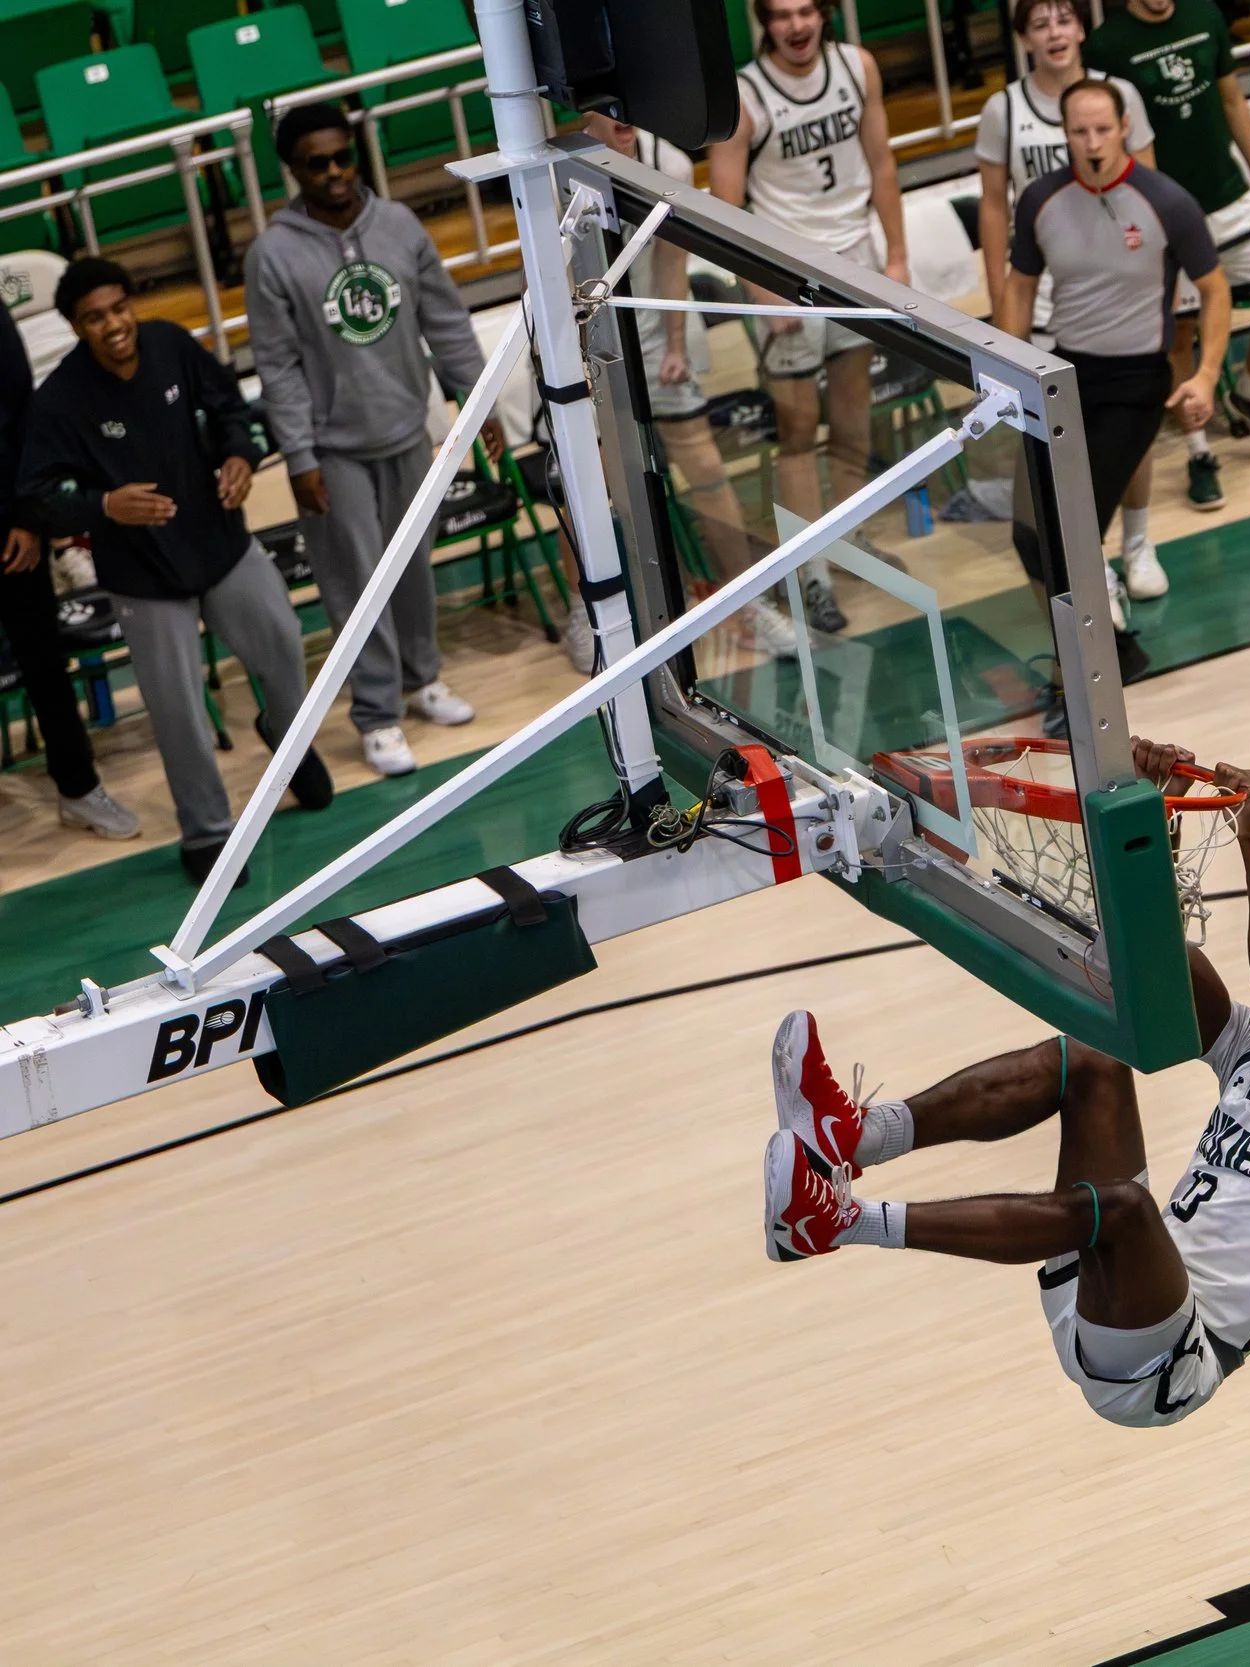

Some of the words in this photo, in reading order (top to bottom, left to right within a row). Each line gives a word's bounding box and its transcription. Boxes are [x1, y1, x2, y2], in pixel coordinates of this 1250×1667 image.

[780, 105, 857, 159] HUSKIES
[818, 154, 837, 193] 3
[147, 989, 268, 1084] BPI
